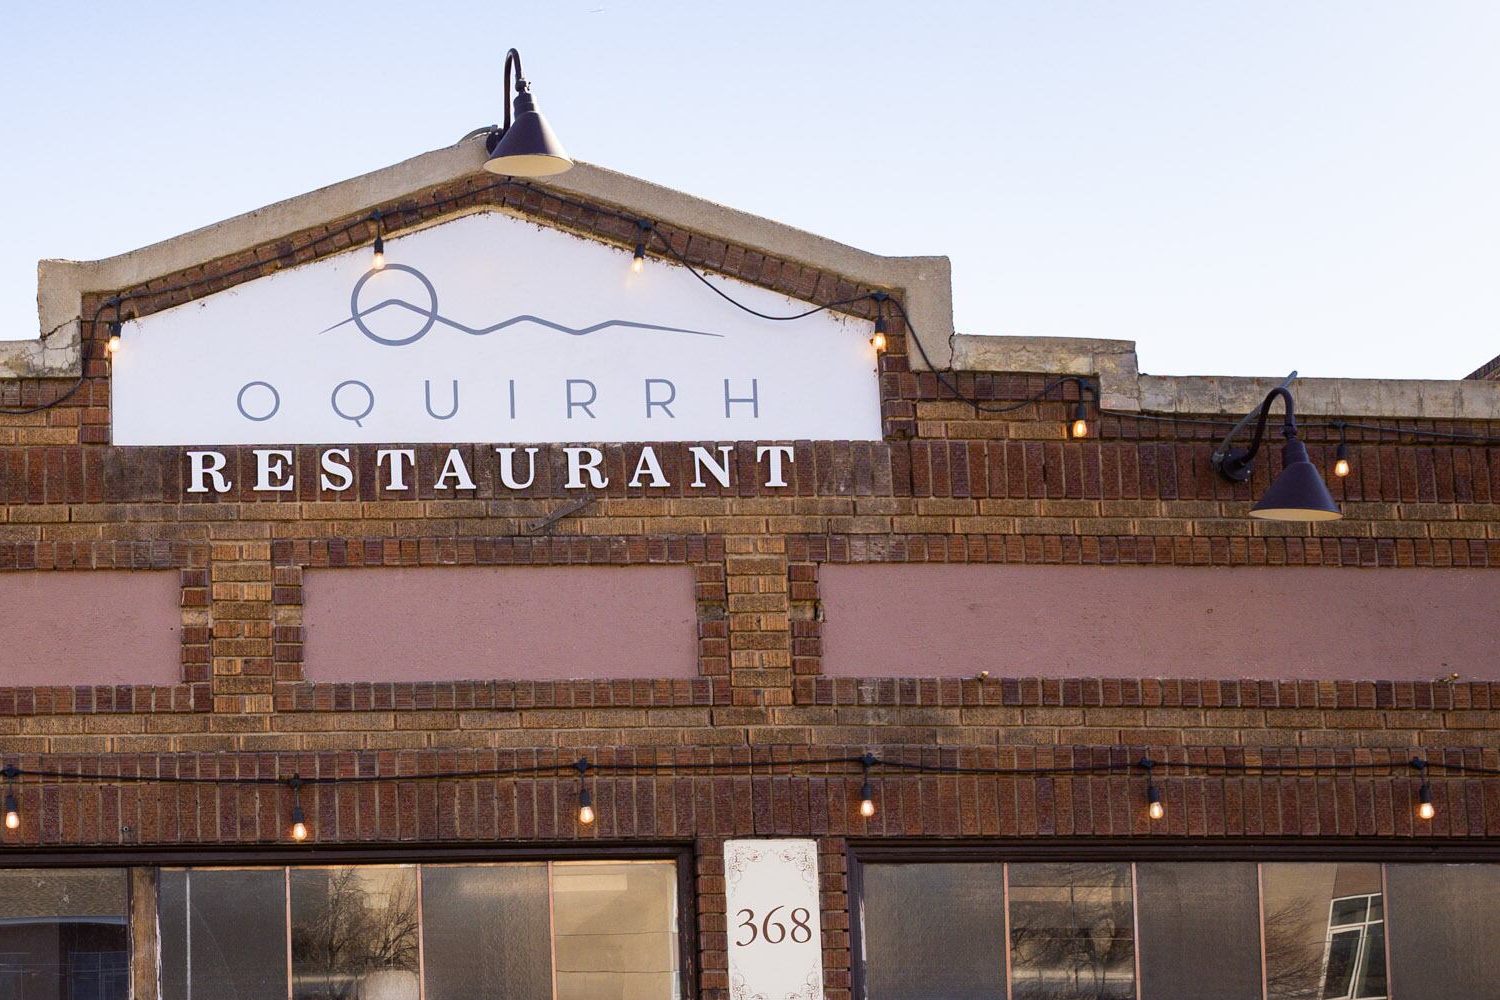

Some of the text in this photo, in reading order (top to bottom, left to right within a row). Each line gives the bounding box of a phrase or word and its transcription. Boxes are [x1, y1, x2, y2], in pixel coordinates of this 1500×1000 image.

[237, 378, 759, 428] OQUIRRH
[186, 444, 794, 493] RESTAURANT
[736, 905, 812, 947] 368
